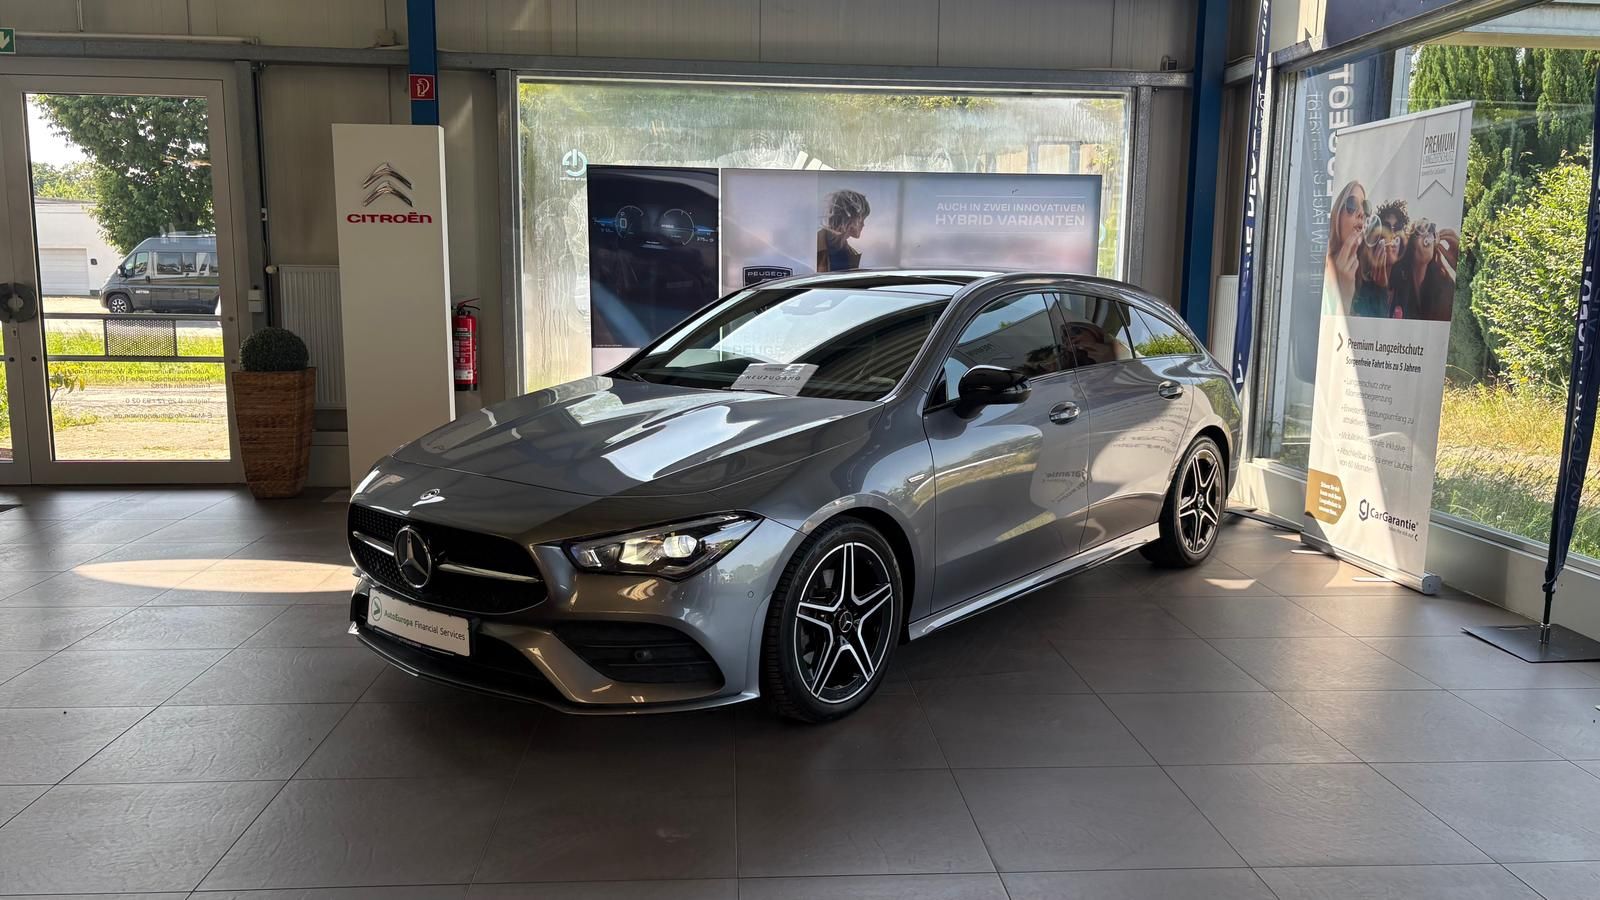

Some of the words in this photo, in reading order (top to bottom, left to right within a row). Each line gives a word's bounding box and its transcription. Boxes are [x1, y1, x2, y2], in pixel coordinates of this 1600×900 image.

[1424, 132, 1455, 154] PREMIUM
[936, 203, 967, 211] AUCH
[969, 203, 980, 211] IN
[983, 203, 1010, 211] ZWEI
[1013, 203, 1085, 212] INNOVATIVEN
[935, 214, 993, 225] HYBRID
[997, 214, 1085, 226] VARIANTEN
[1347, 338, 1374, 351] Premium
[1375, 340, 1424, 355] Langzeitschutz
[1346, 356, 1371, 367] Sorgenfreie
[1371, 359, 1384, 369] Fahrt
[1399, 362, 1404, 371] 5
[1403, 363, 1421, 373] Jahren
[383, 609, 413, 627] AutoEuropa
[414, 620, 438, 635] Financial
[440, 627, 465, 641] Services
